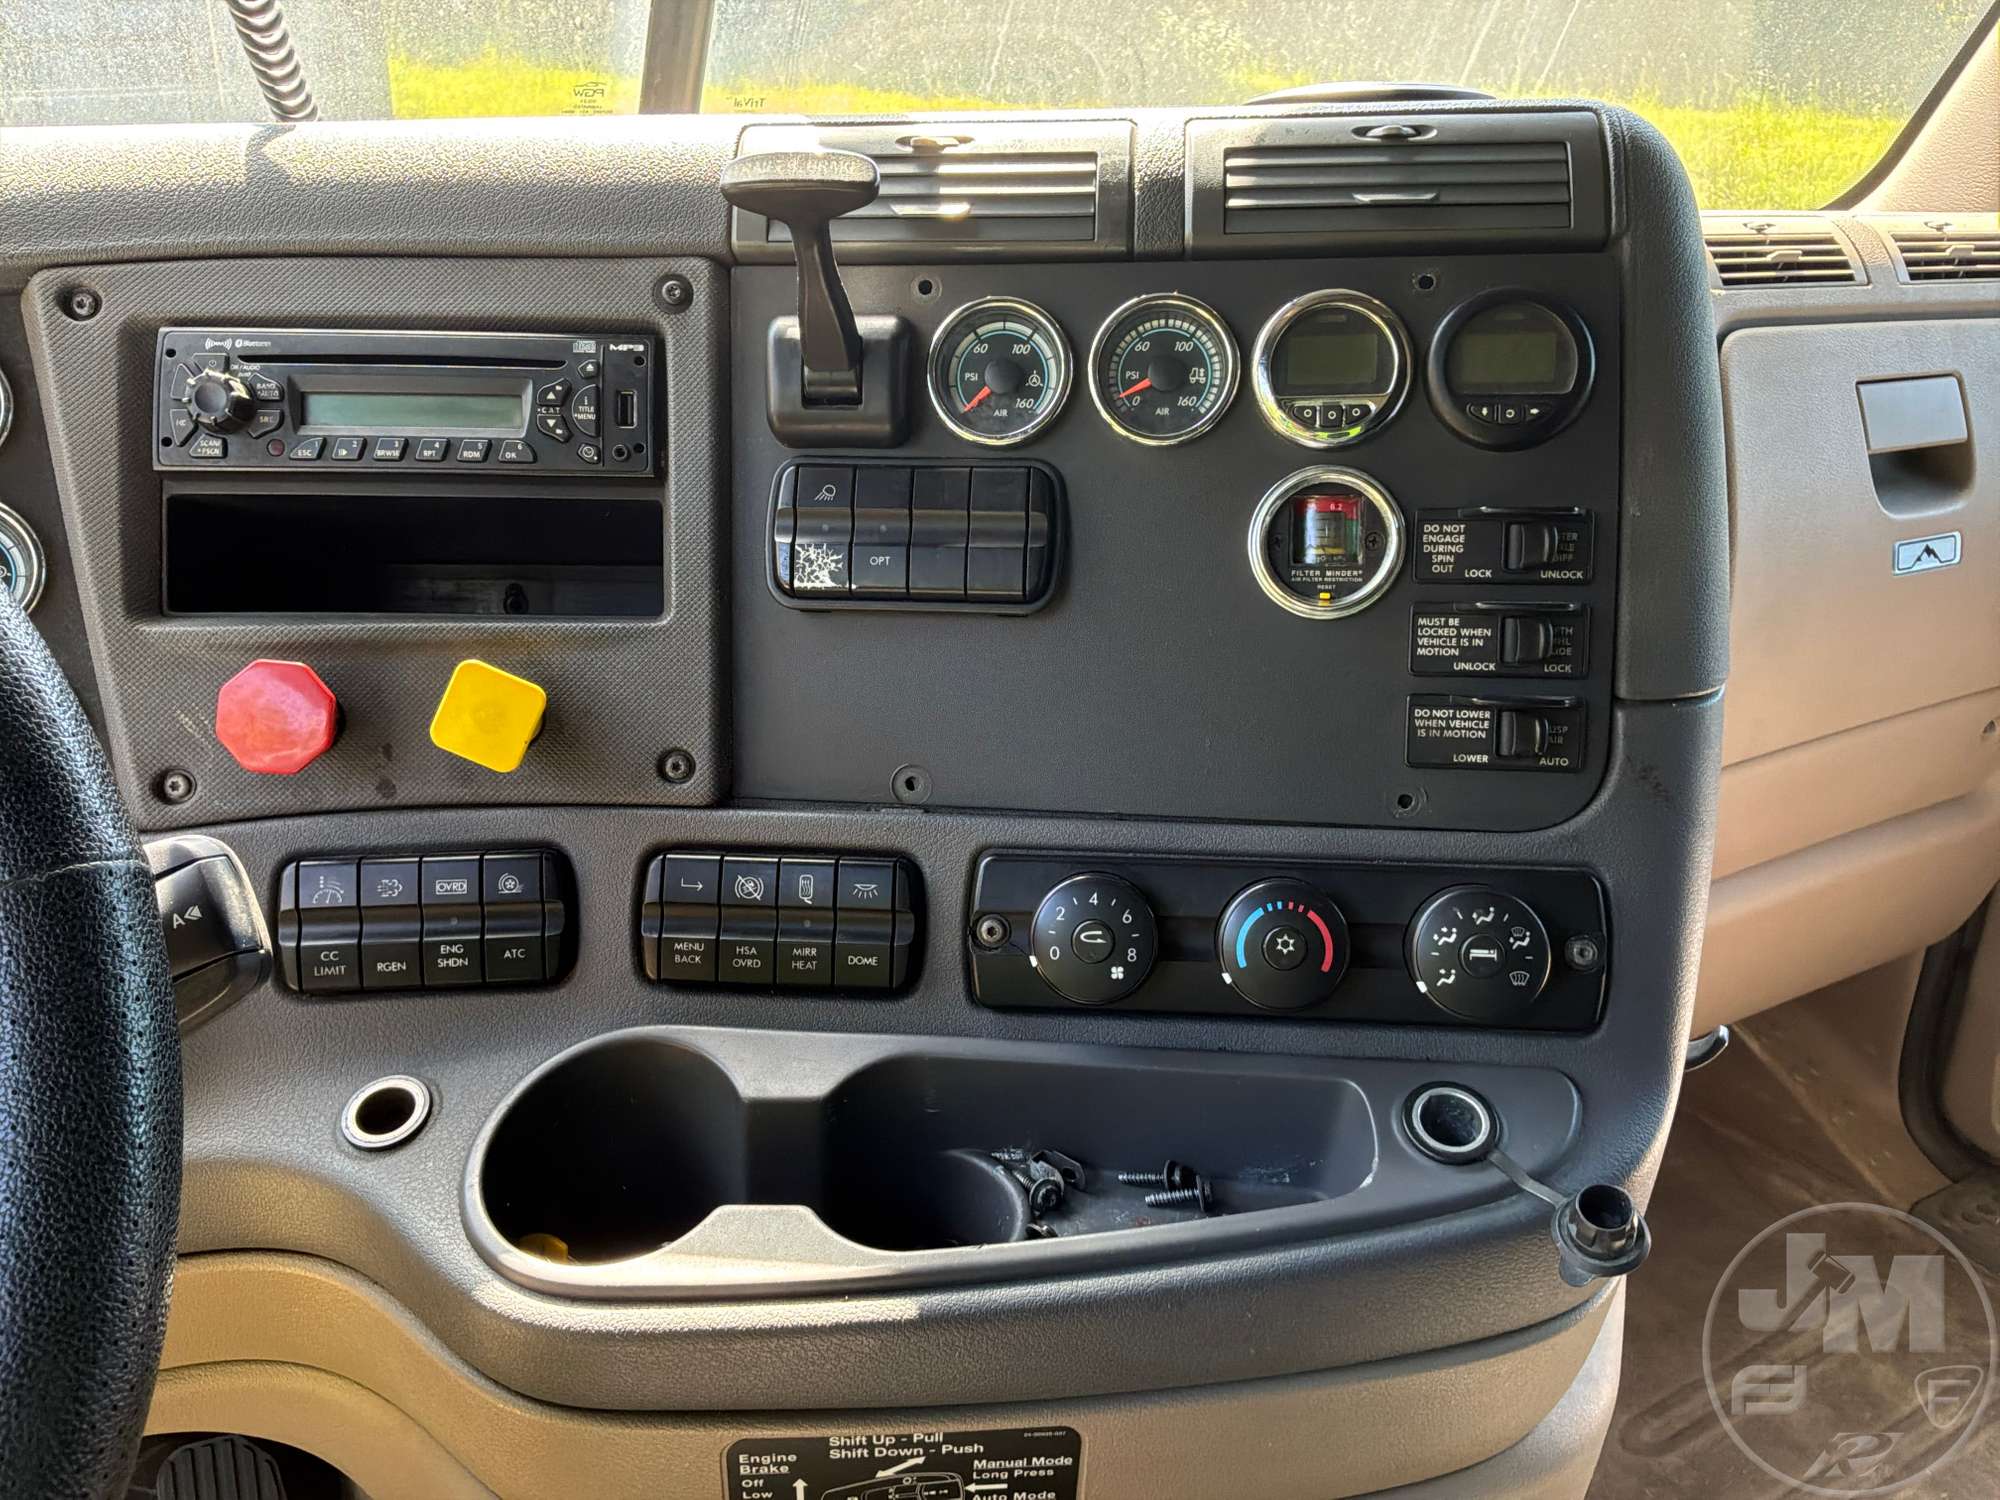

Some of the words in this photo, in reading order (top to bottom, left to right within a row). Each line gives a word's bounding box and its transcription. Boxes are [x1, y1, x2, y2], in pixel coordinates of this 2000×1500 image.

[609, 344, 644, 352] MP3
[973, 343, 988, 354] 60
[1012, 343, 1031, 355] 100
[1135, 341, 1150, 352] 60
[1174, 341, 1193, 352] 100
[965, 372, 978, 381] PSI
[1125, 370, 1139, 380] PSI
[1016, 397, 1034, 409] 160
[1132, 395, 1140, 407] 0
[1177, 396, 1197, 407] 160
[994, 408, 1008, 417] AIR
[1155, 407, 1169, 416] AIR
[1424, 524, 1440, 533] DO
[1443, 524, 1466, 533] NOT
[1423, 534, 1466, 543] ENGAGE
[1423, 545, 1464, 553] DURING
[869, 556, 891, 566] OPT
[1432, 555, 1454, 563] SPIN
[1432, 565, 1454, 573] OUT
[1465, 569, 1492, 578] LOCK
[1540, 570, 1583, 579] UNLOCK
[1417, 617, 1445, 626] MUST
[1448, 618, 1460, 626] BE
[1417, 628, 1457, 636] LOCKED
[1460, 628, 1491, 636] WHEN
[1417, 638, 1457, 646] VEHICLE
[1460, 638, 1469, 646] IS
[1472, 638, 1484, 646] IN
[1416, 648, 1459, 656] MOTION
[1453, 663, 1496, 671] UNLOCK
[1544, 664, 1572, 673] LOCK
[1414, 709, 1431, 717] DO
[1432, 709, 1454, 718] NOT
[1456, 710, 1491, 719] LOWER
[1415, 719, 1446, 728] WHEN
[1449, 720, 1489, 729] VEHICLE
[1417, 729, 1426, 737] IS
[1443, 730, 1486, 738] MOTION
[1453, 754, 1489, 763] LOWER
[1539, 757, 1569, 766] AUTO
[437, 880, 466, 893] OVRD
[1089, 892, 1098, 905] 4
[1056, 906, 1065, 921] 2
[1122, 909, 1132, 924] 6
[172, 913, 187, 929] A
[440, 944, 464, 955] ENG
[673, 942, 705, 952] MENU
[735, 946, 757, 955] HSA
[792, 947, 817, 957] MIRR
[320, 951, 340, 962] CC
[503, 948, 526, 959] ATC
[1049, 945, 1060, 960] 0
[1127, 948, 1137, 962] 8
[437, 957, 469, 968] SHDN
[674, 954, 702, 964] BACK
[732, 958, 761, 969] OVRD
[847, 956, 879, 967] DOME
[376, 961, 407, 973] RGEN
[791, 960, 819, 971] HEAT
[314, 965, 347, 977] LIMIT
[828, 1435, 867, 1447] Shift
[872, 1435, 896, 1447] Up
[912, 1432, 944, 1444] Pull
[829, 1448, 869, 1459] Shift
[874, 1447, 924, 1458] Down
[941, 1443, 984, 1454] Push
[738, 1453, 797, 1465] Engine
[973, 1457, 1027, 1470] Manual
[1031, 1456, 1073, 1467] Mode
[740, 1464, 790, 1474] Brake
[972, 1471, 1008, 1480] Long
[1013, 1469, 1054, 1478] Press
[741, 1479, 764, 1488] Off
[742, 1491, 773, 1499] Low
[1013, 1491, 1056, 1500] Mode
